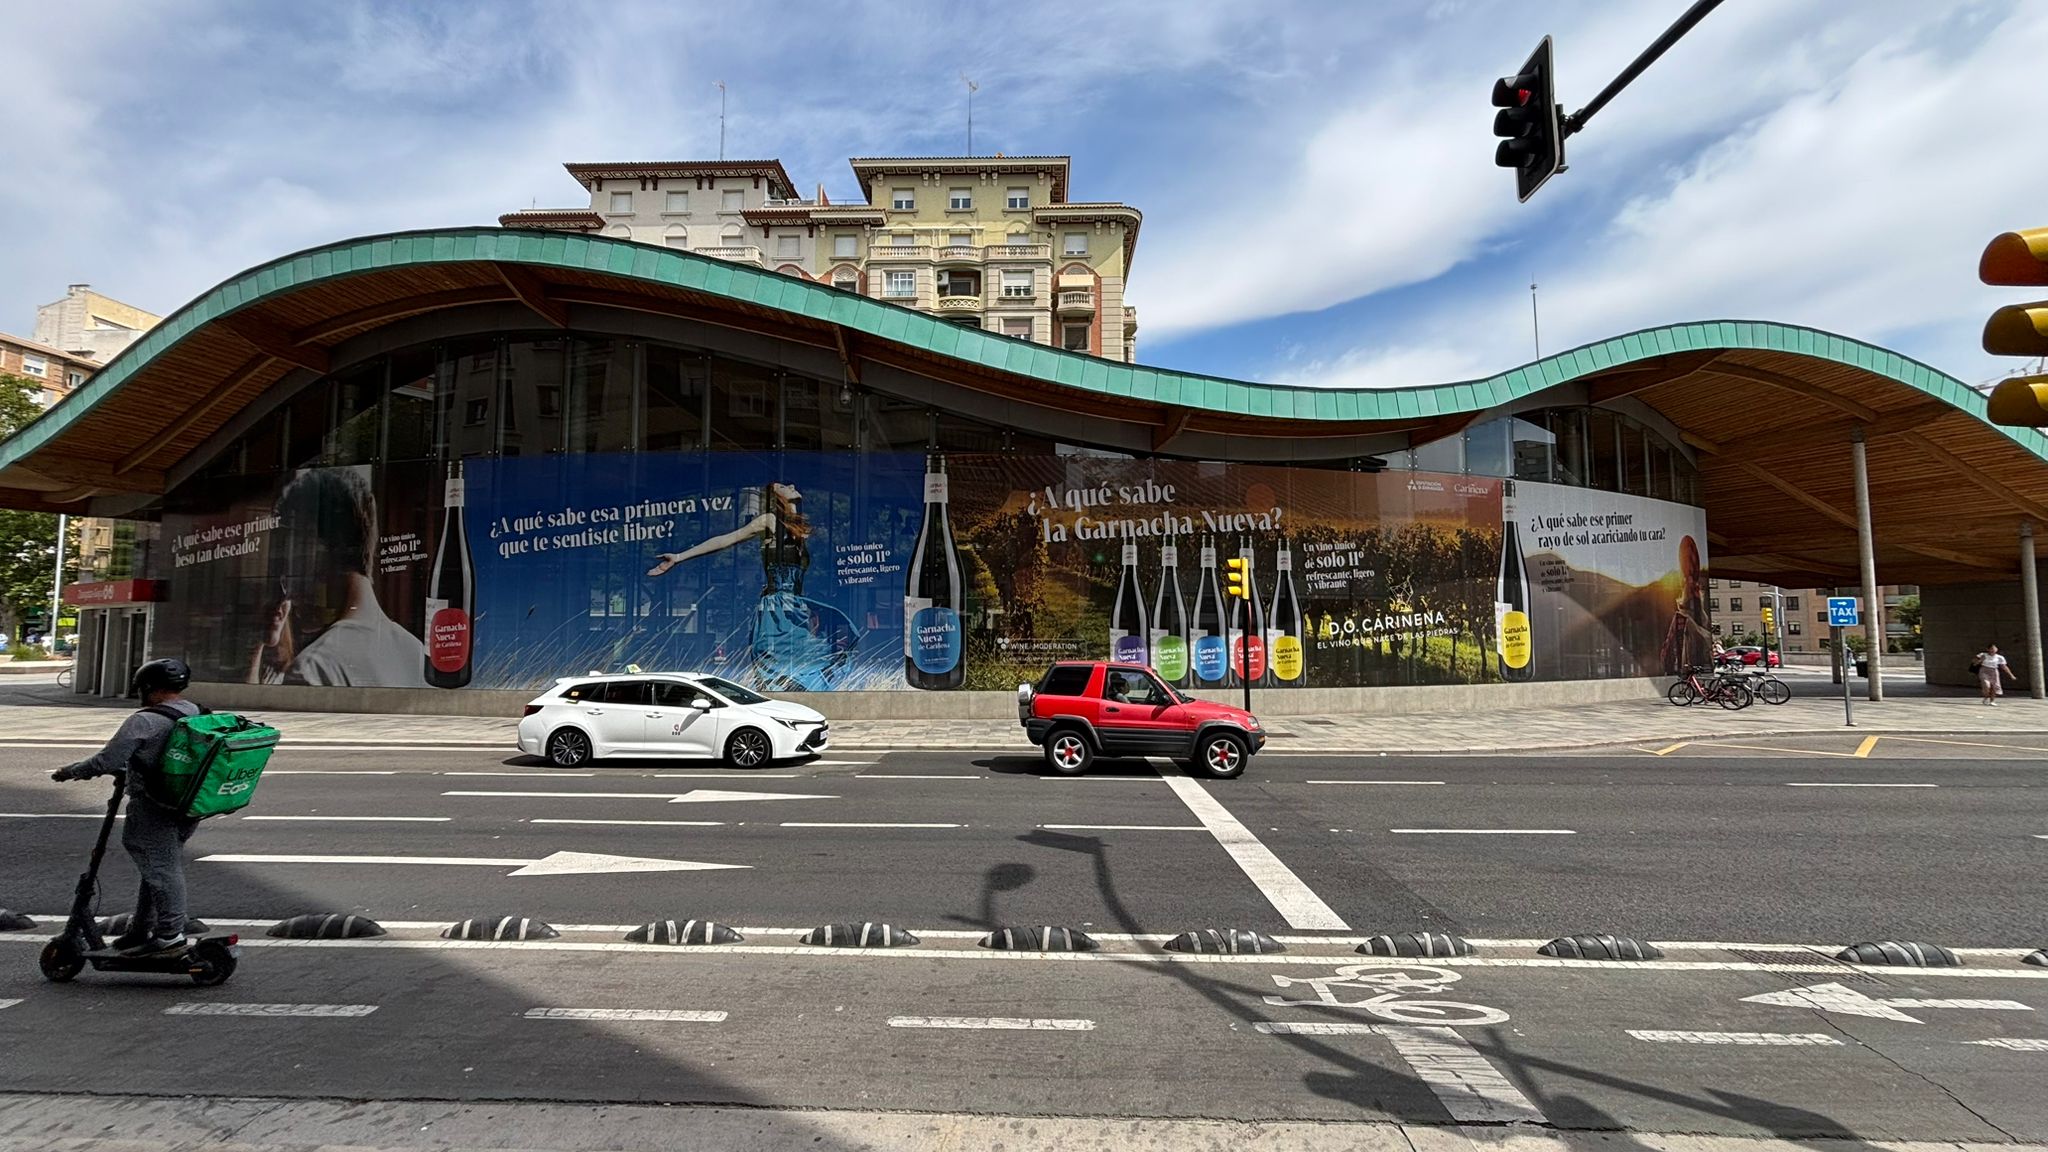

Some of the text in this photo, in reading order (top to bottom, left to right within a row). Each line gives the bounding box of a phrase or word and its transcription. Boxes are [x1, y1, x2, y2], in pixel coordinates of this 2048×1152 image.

[1027, 479, 1177, 516] ¿A qué sabe
[490, 496, 733, 538] ¿A qué sabe esa primera vez
[1530, 512, 1632, 532] ¿A qué sabe ese primer
[1043, 507, 1283, 543] la Garnacha Nueva?
[172, 516, 281, 553] ¿A qué sabe ese primer
[498, 520, 675, 558] que te sentiste libre?
[1538, 528, 1666, 550] rayo de sol acariciando tu cara?
[175, 536, 260, 568] beso tan deseado?
[388, 541, 408, 554] solo
[836, 541, 884, 553] Un vino único
[1303, 541, 1356, 552] Un vino único
[836, 558, 846, 566] de
[847, 551, 873, 565] solo
[1304, 559, 1315, 568] de
[1316, 551, 1345, 568] solo
[837, 564, 900, 576] refrescante, ligero
[1306, 569, 1375, 581] refrescante, ligero
[1546, 566, 1561, 576] solo
[844, 576, 874, 584] vibrante
[1307, 580, 1347, 592] y vibrante
[1830, 607, 1856, 616] TAXI
[435, 623, 467, 633] Garnacha
[916, 624, 956, 634] Garnacha
[1504, 625, 1528, 634] Garnacha
[918, 634, 943, 643] Nueva
[1330, 640, 1351, 648] VINO
[1374, 635, 1394, 643] NACE
[1397, 633, 1408, 641] DE
[1410, 631, 1425, 639] LAS
[1427, 628, 1458, 637] PIEDRAS
[1033, 642, 1077, 650] MODERATION
[1118, 646, 1144, 654] Garnacha
[1237, 645, 1262, 653] Gaacha
[226, 768, 260, 781] Uber
